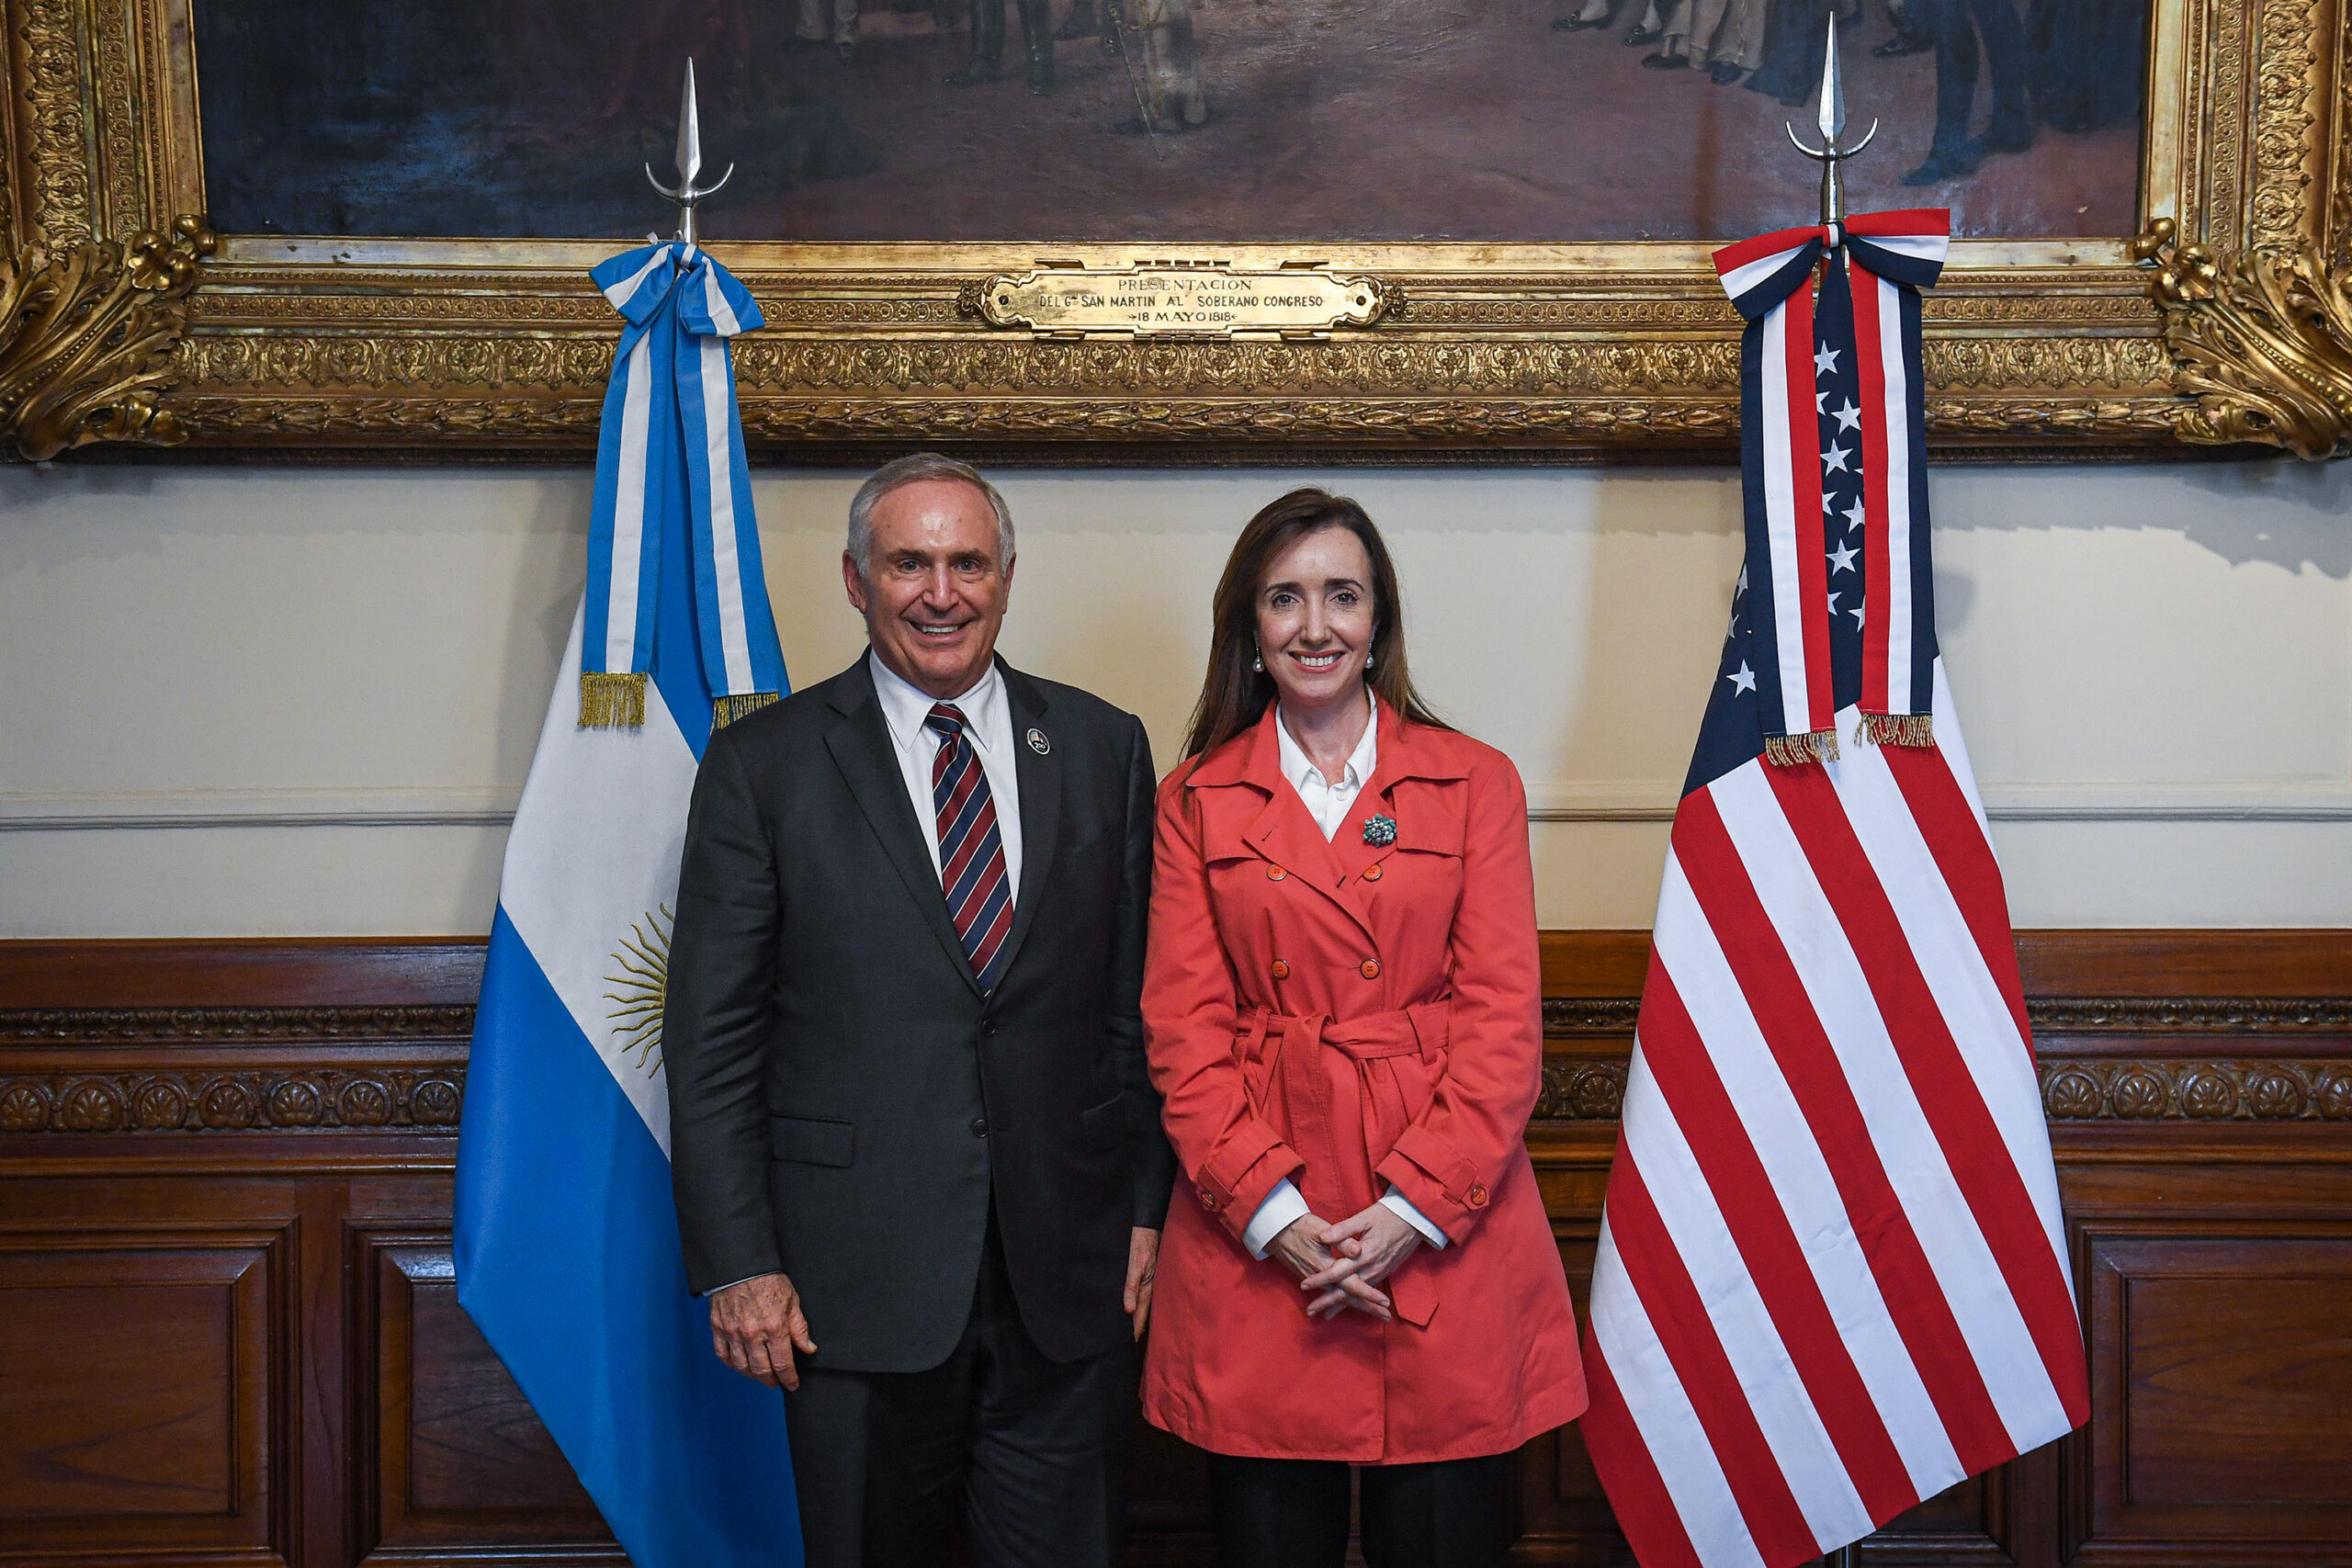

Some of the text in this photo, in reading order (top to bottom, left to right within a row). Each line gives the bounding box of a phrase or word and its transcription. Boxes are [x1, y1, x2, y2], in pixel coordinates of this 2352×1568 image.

[1118, 278, 1251, 291] PRESENTACION
[1039, 296, 1061, 308] DEL
[1080, 295, 1104, 308] SAN
[1110, 296, 1156, 308] MARTIN
[1166, 296, 1184, 307] AL
[1197, 295, 1259, 308] SOBERANO
[1263, 295, 1323, 308] CONGRESO
[1137, 311, 1231, 322] 18 MAYO 1818
